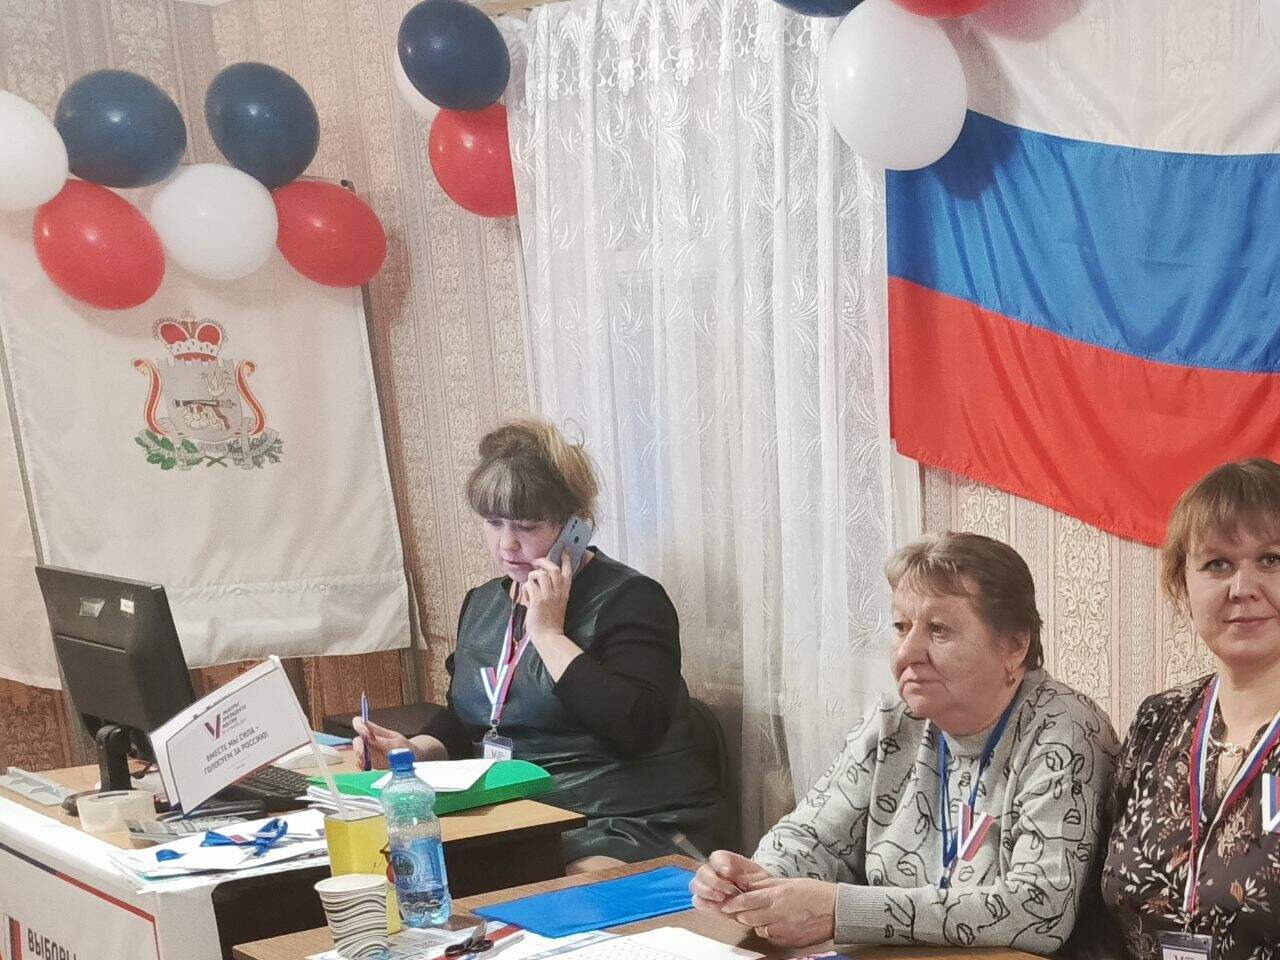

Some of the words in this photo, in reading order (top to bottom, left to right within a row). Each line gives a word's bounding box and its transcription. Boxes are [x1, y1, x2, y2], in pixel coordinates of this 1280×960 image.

[204, 753, 234, 775] ГОЛОСУЕМ
[232, 747, 242, 757] ЗА
[241, 730, 270, 751] РОССИЮ!
[206, 743, 227, 762] ВМЕСТЕ
[227, 736, 240, 748] МЫ
[239, 727, 255, 741] СИЛА
